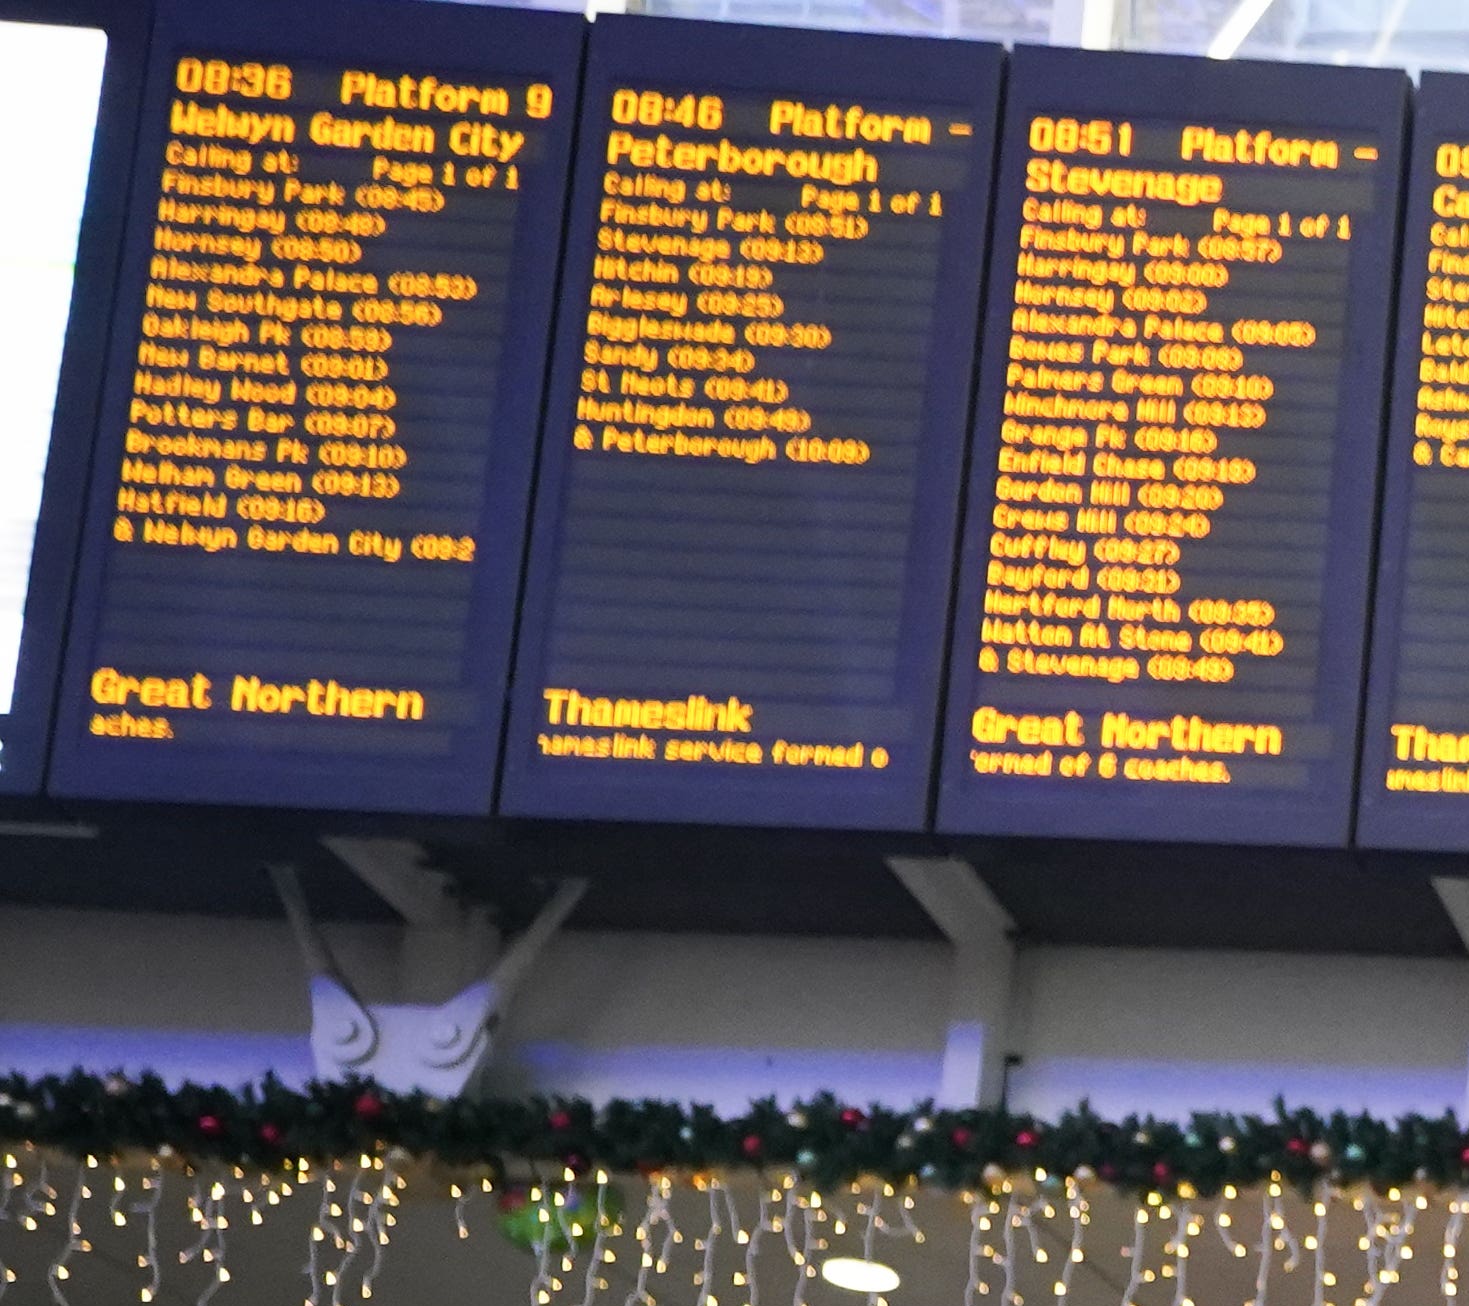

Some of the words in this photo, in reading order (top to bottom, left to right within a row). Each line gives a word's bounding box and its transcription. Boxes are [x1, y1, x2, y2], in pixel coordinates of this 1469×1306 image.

[177, 60, 291, 99] 08:36
[340, 72, 509, 115] Platform
[526, 85, 553, 118] 9
[171, 101, 296, 143] Welwyn
[309, 112, 435, 152] Garden
[449, 122, 524, 161] City
[612, 90, 723, 130] 08:46
[770, 101, 932, 144] Platform
[607, 132, 878, 185] Peterborough
[1029, 117, 1133, 155] 08:51
[1181, 127, 1339, 168] Platform
[167, 143, 252, 174] Calling
[373, 157, 433, 186] Page
[466, 166, 496, 187] of
[507, 167, 518, 189] 1
[1026, 158, 1223, 205] Stevenage
[162, 170, 275, 204] Finsbury
[284, 178, 344, 204] Park
[600, 199, 708, 232] Finsbury
[717, 207, 775, 233] Park
[598, 227, 731, 261] Stevenage
[151, 257, 285, 287] Alexandra
[293, 265, 378, 294] Palace
[147, 285, 197, 310] New
[208, 290, 342, 321] Southgate
[134, 373, 221, 402] Hadley
[231, 379, 297, 404] Wood
[130, 400, 237, 430] Potters
[247, 407, 293, 433] Bar
[577, 398, 714, 428] Huntingdon
[998, 446, 1086, 475] Enfield
[1092, 452, 1166, 481] Chase
[118, 489, 227, 518] Hatfield
[91, 669, 210, 708] Great
[231, 677, 424, 718] Northern
[545, 689, 752, 732] Thameslink
[972, 707, 1084, 746] Great
[1100, 713, 1282, 754] Northern
[665, 740, 762, 763] service
[772, 741, 863, 767] formed
